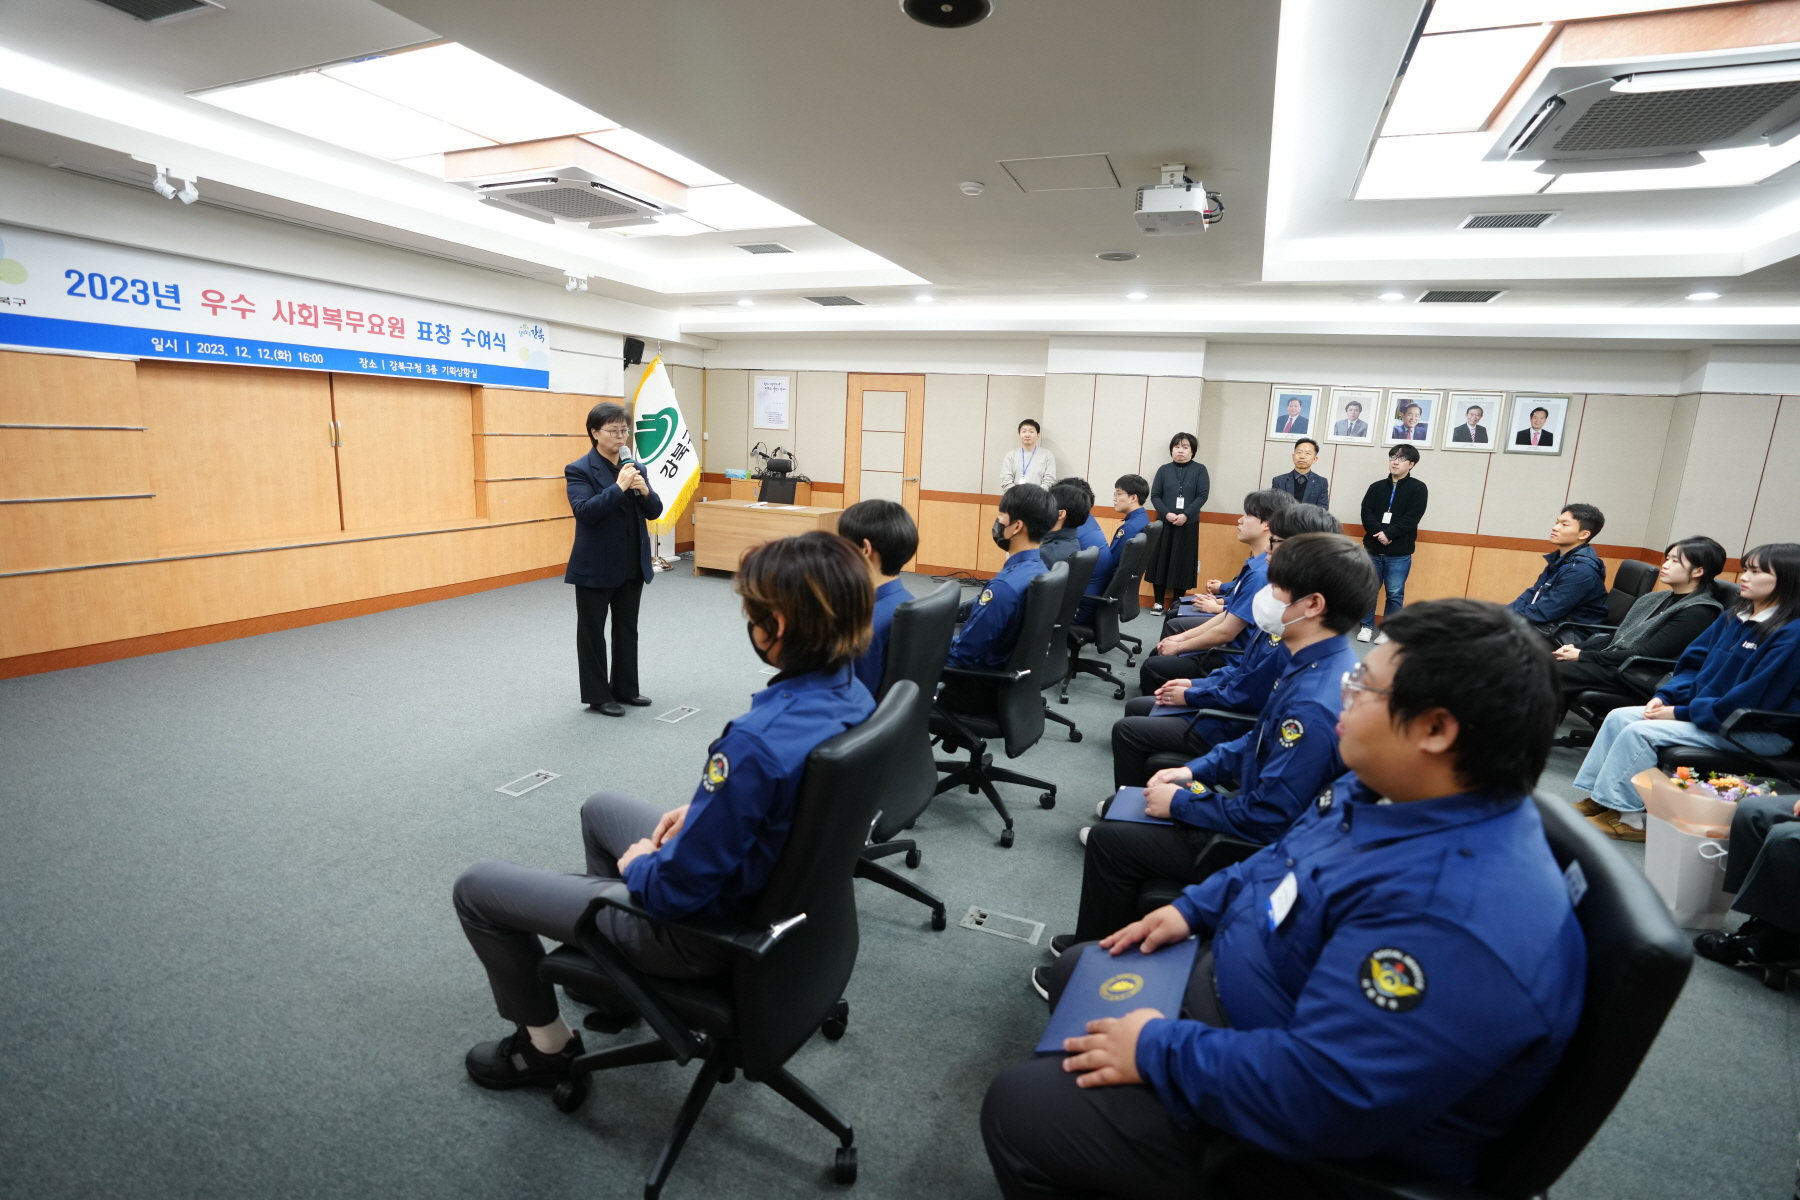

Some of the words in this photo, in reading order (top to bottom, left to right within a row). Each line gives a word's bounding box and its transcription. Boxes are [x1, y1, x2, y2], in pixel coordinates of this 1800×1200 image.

[65, 269, 181, 311] 2023년
[201, 289, 256, 320] 우수
[272, 299, 405, 339] 사회복무요원
[417, 320, 451, 345] 표창
[460, 327, 506, 352] 수여식
[151, 337, 178, 353] 일시
[197, 342, 228, 357] 2023.
[235, 346, 252, 359] 12.
[298, 352, 324, 364] 16:00
[358, 357, 378, 370] 장소
[389, 360, 422, 374] 강북구청
[425, 364, 439, 376] 3층
[441, 366, 478, 379] 기획상황실
